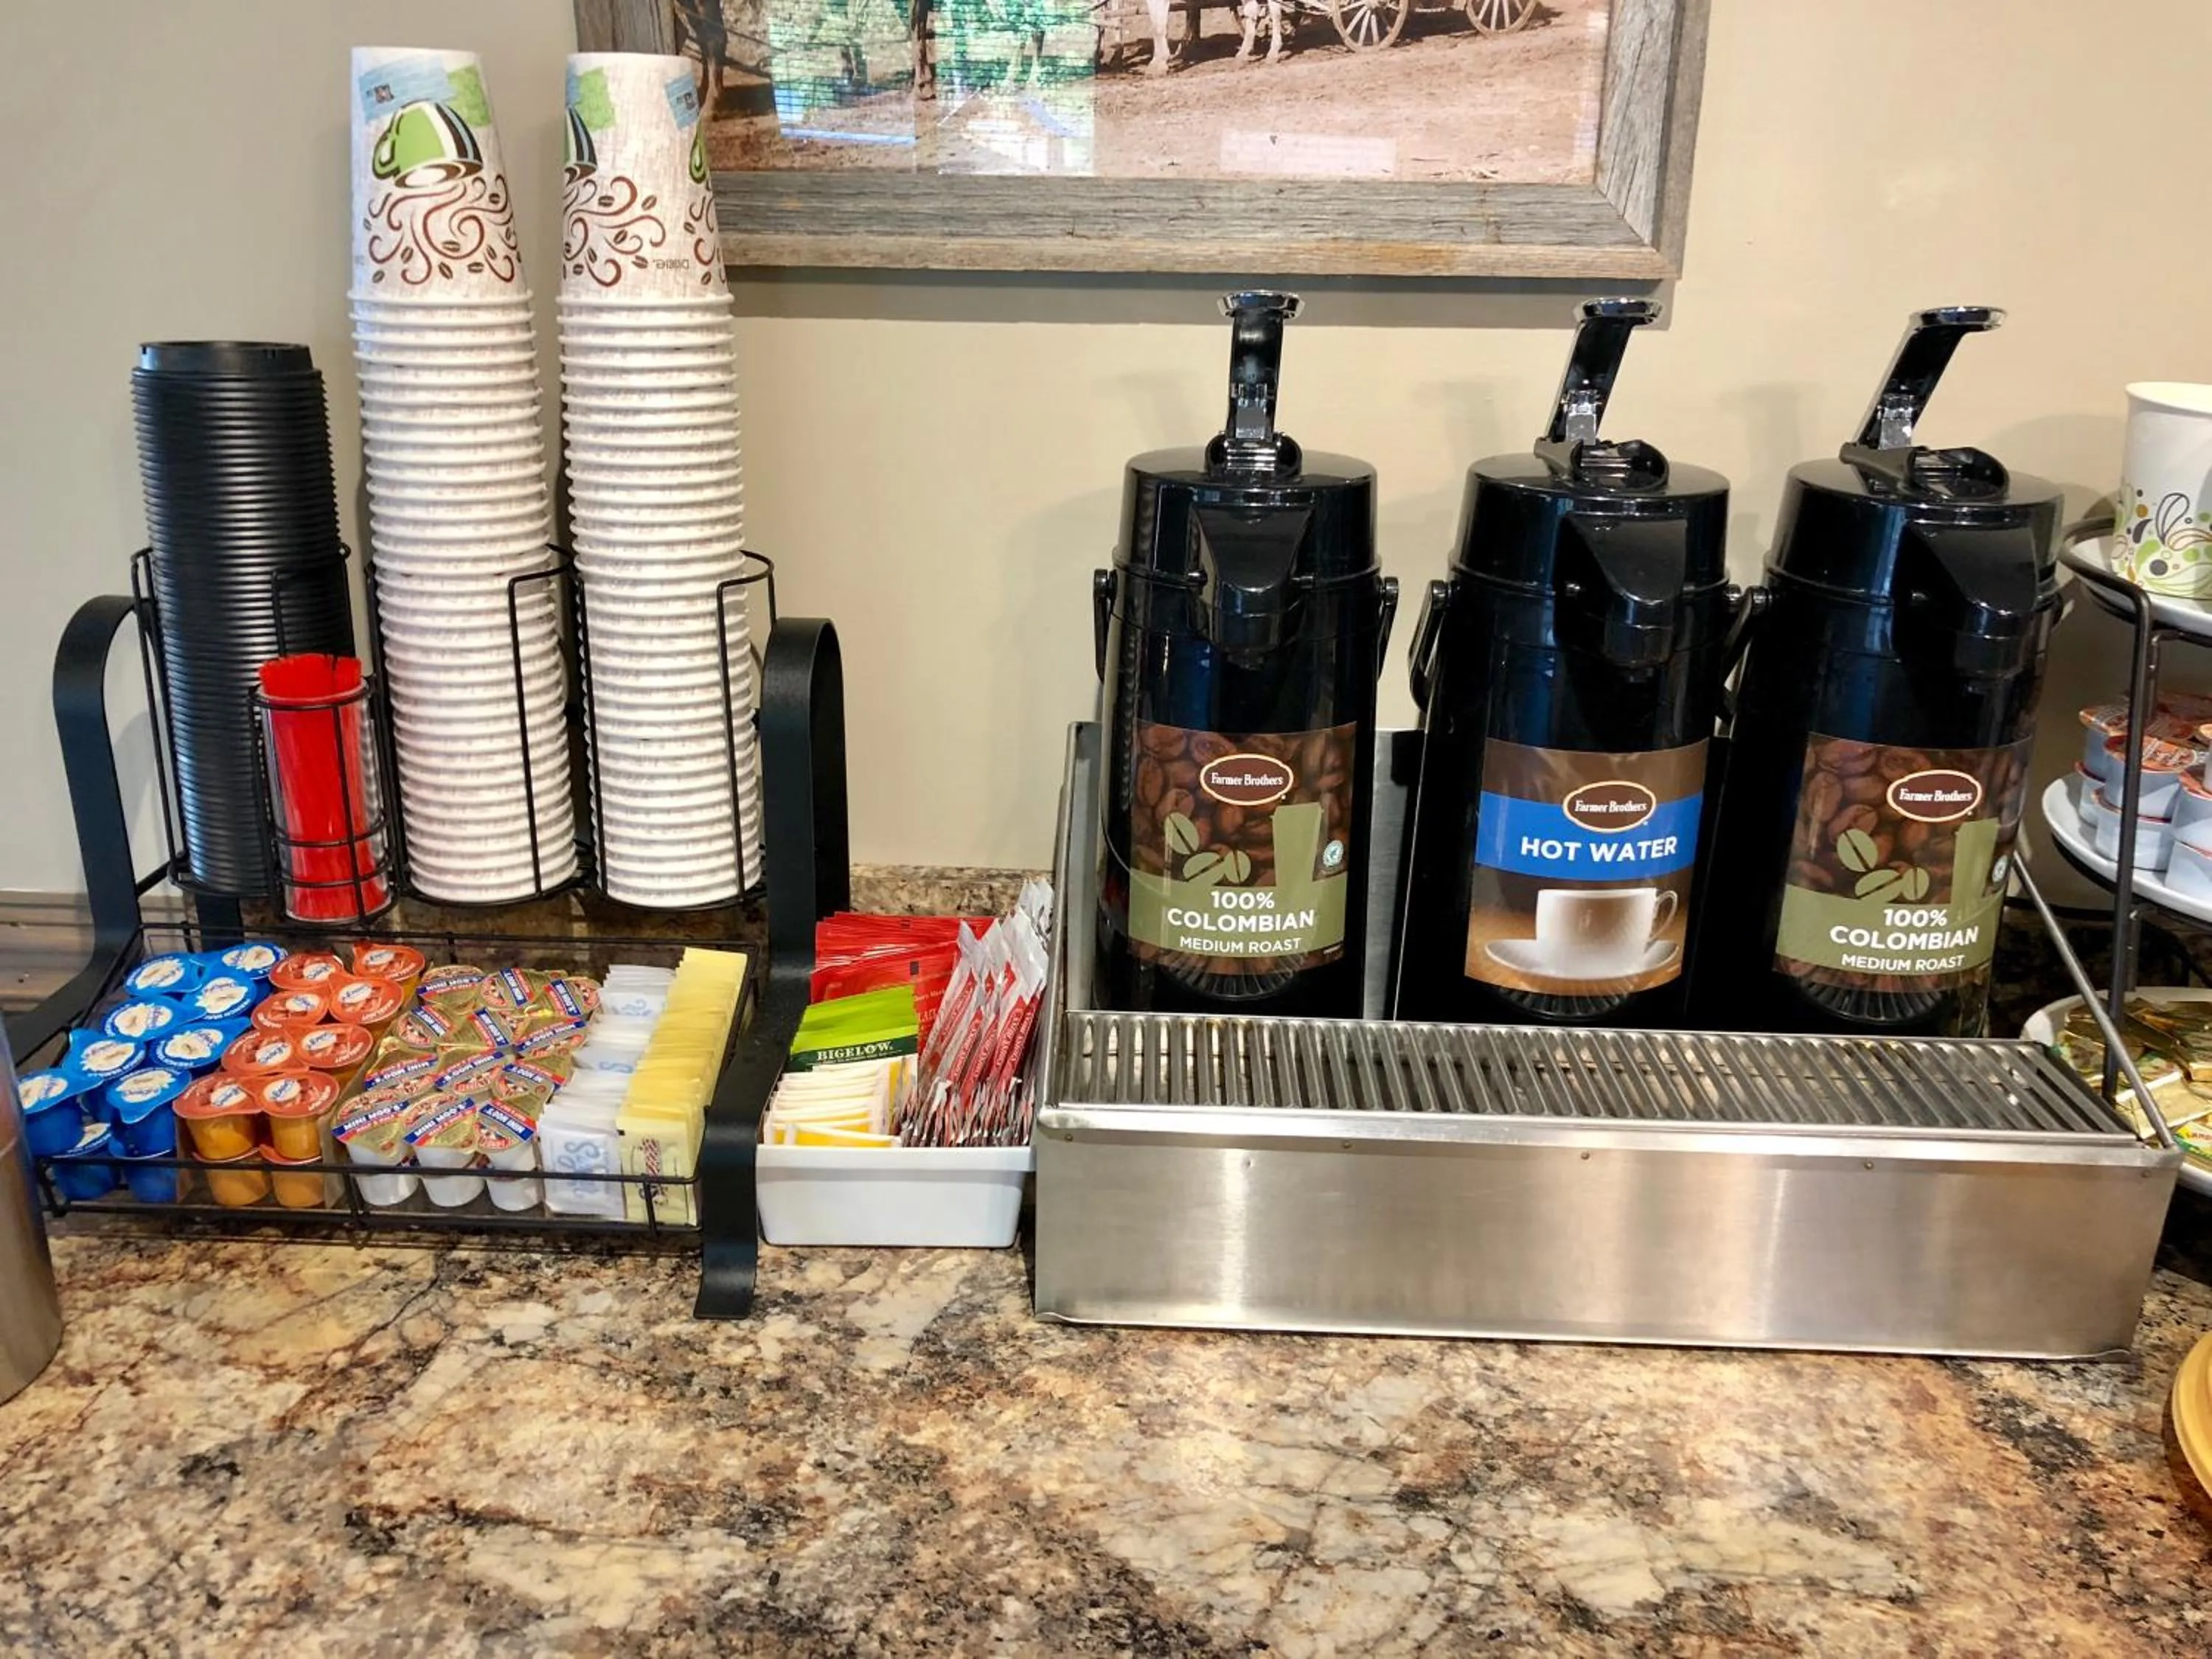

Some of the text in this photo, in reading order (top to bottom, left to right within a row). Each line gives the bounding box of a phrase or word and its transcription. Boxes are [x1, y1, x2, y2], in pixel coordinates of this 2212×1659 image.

[1211, 772, 1284, 786] Farmer Brothers
[1899, 788, 1972, 802] Farmer Brothers
[1575, 800, 1646, 813] Farmer Brothers
[1520, 835, 1677, 862] HOT WATER
[1211, 891, 1275, 910] 100%
[1167, 908, 1315, 933] COLOMBIAN
[1883, 908, 1947, 928] 100%
[1180, 936, 1301, 953] MEDIUM ROAST
[1829, 925, 1979, 950] COLOMBIAN
[1842, 953, 1965, 971] MEDIUM ROAST
[816, 1040, 891, 1060] BIGELOW
[344, 1117, 366, 1130] MINI
[414, 1119, 436, 1136] MINI
